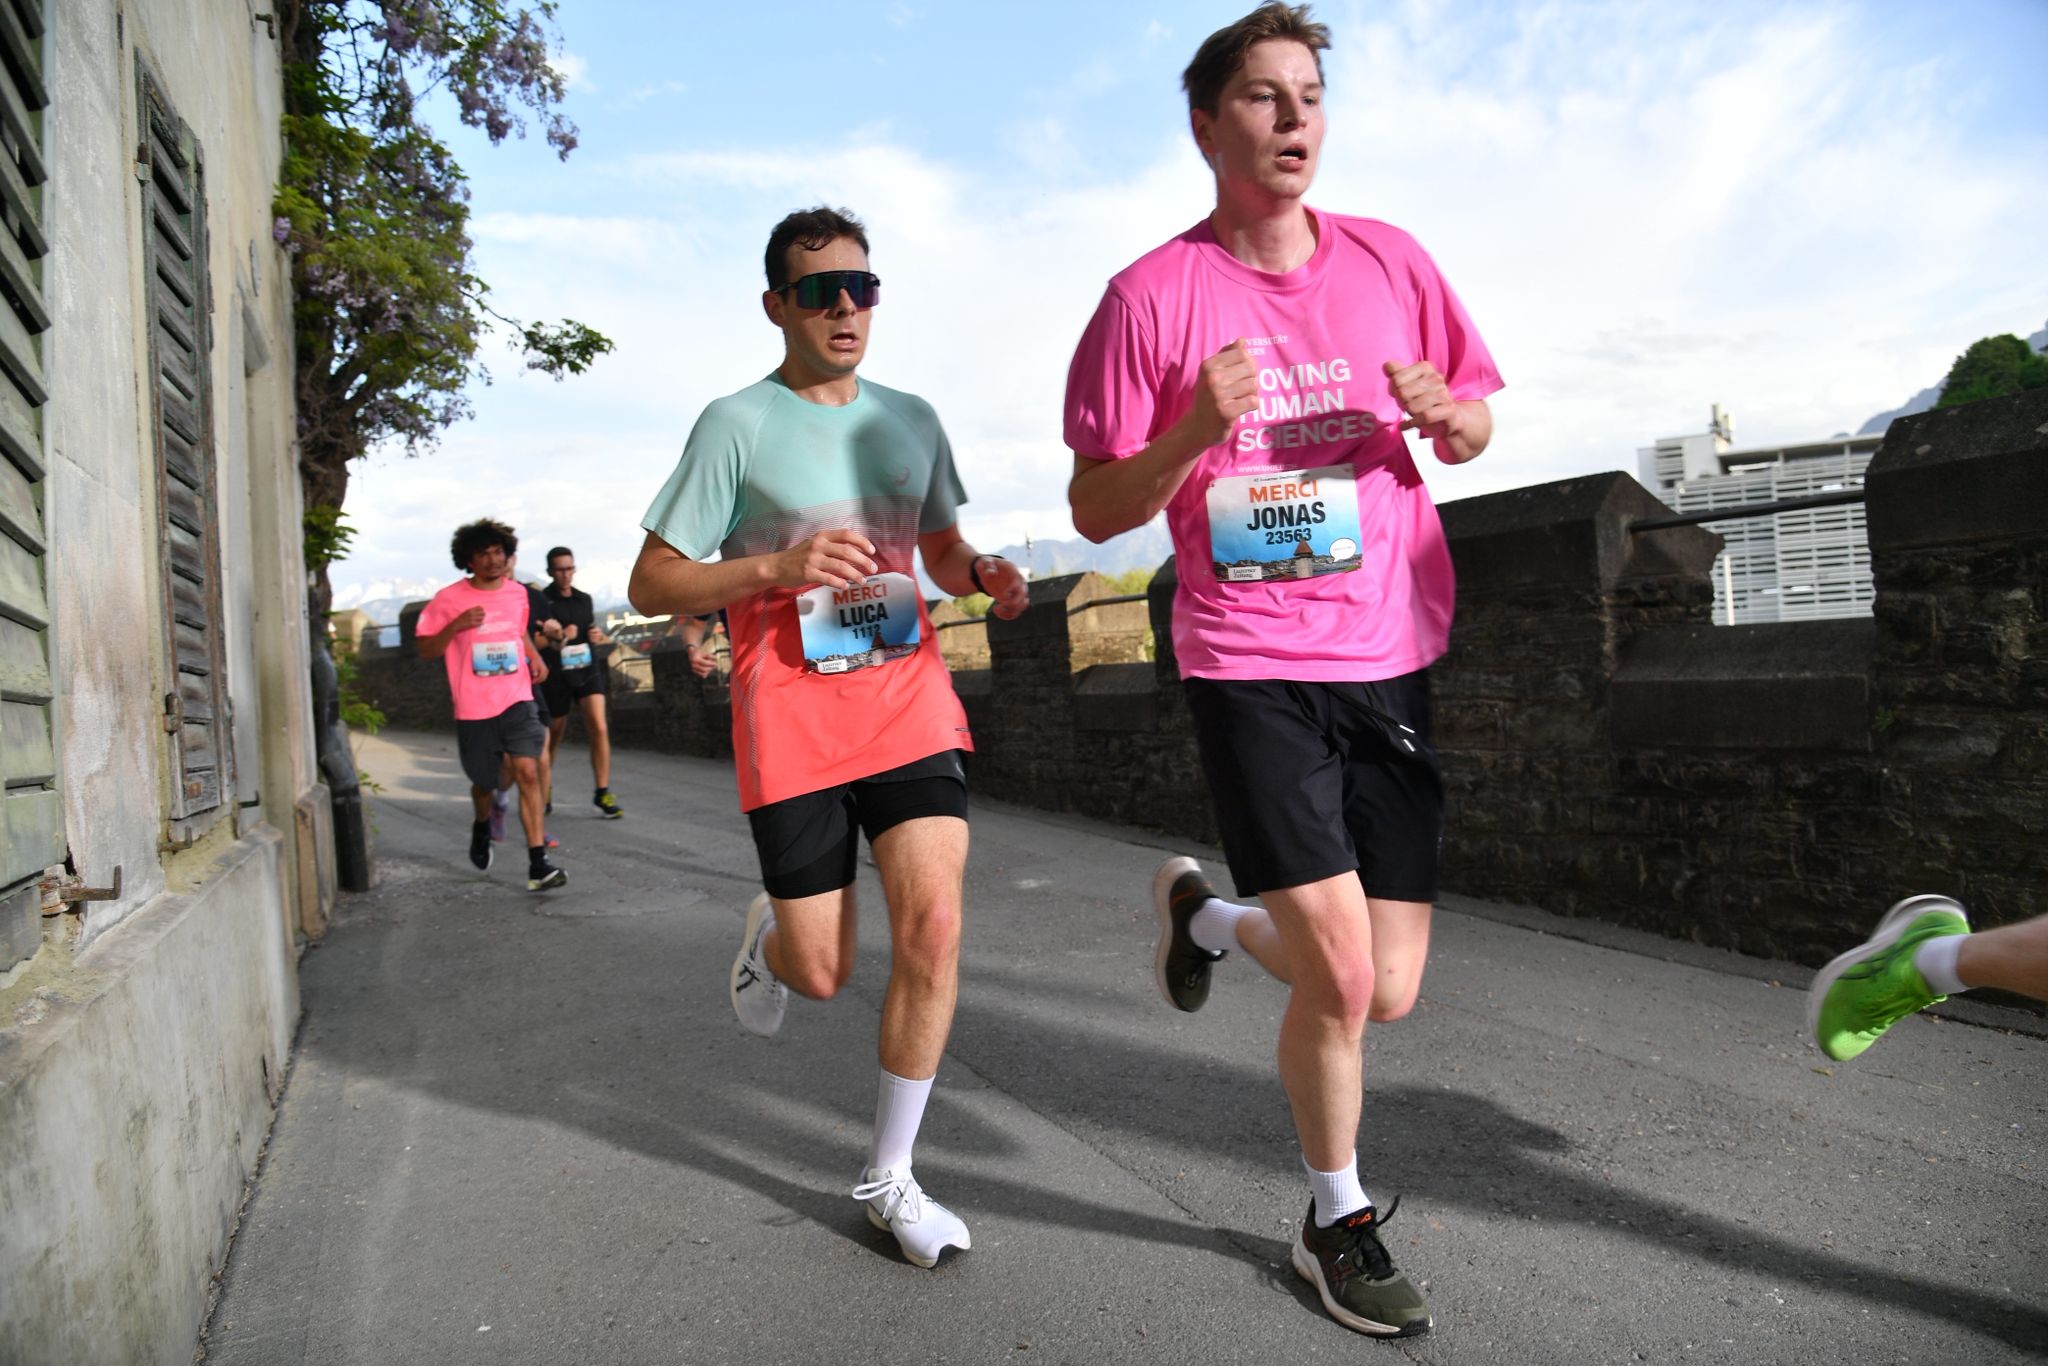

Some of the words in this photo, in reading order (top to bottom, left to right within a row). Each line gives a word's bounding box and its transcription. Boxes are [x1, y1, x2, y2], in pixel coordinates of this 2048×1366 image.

[1258, 358, 1352, 391] OVING
[1237, 413, 1376, 452] SCIENCES
[1248, 480, 1319, 503] MERCI
[1247, 501, 1326, 531] JONAS
[1265, 528, 1312, 545] 23563
[832, 583, 888, 605] MERCI
[839, 602, 889, 627] LUCA
